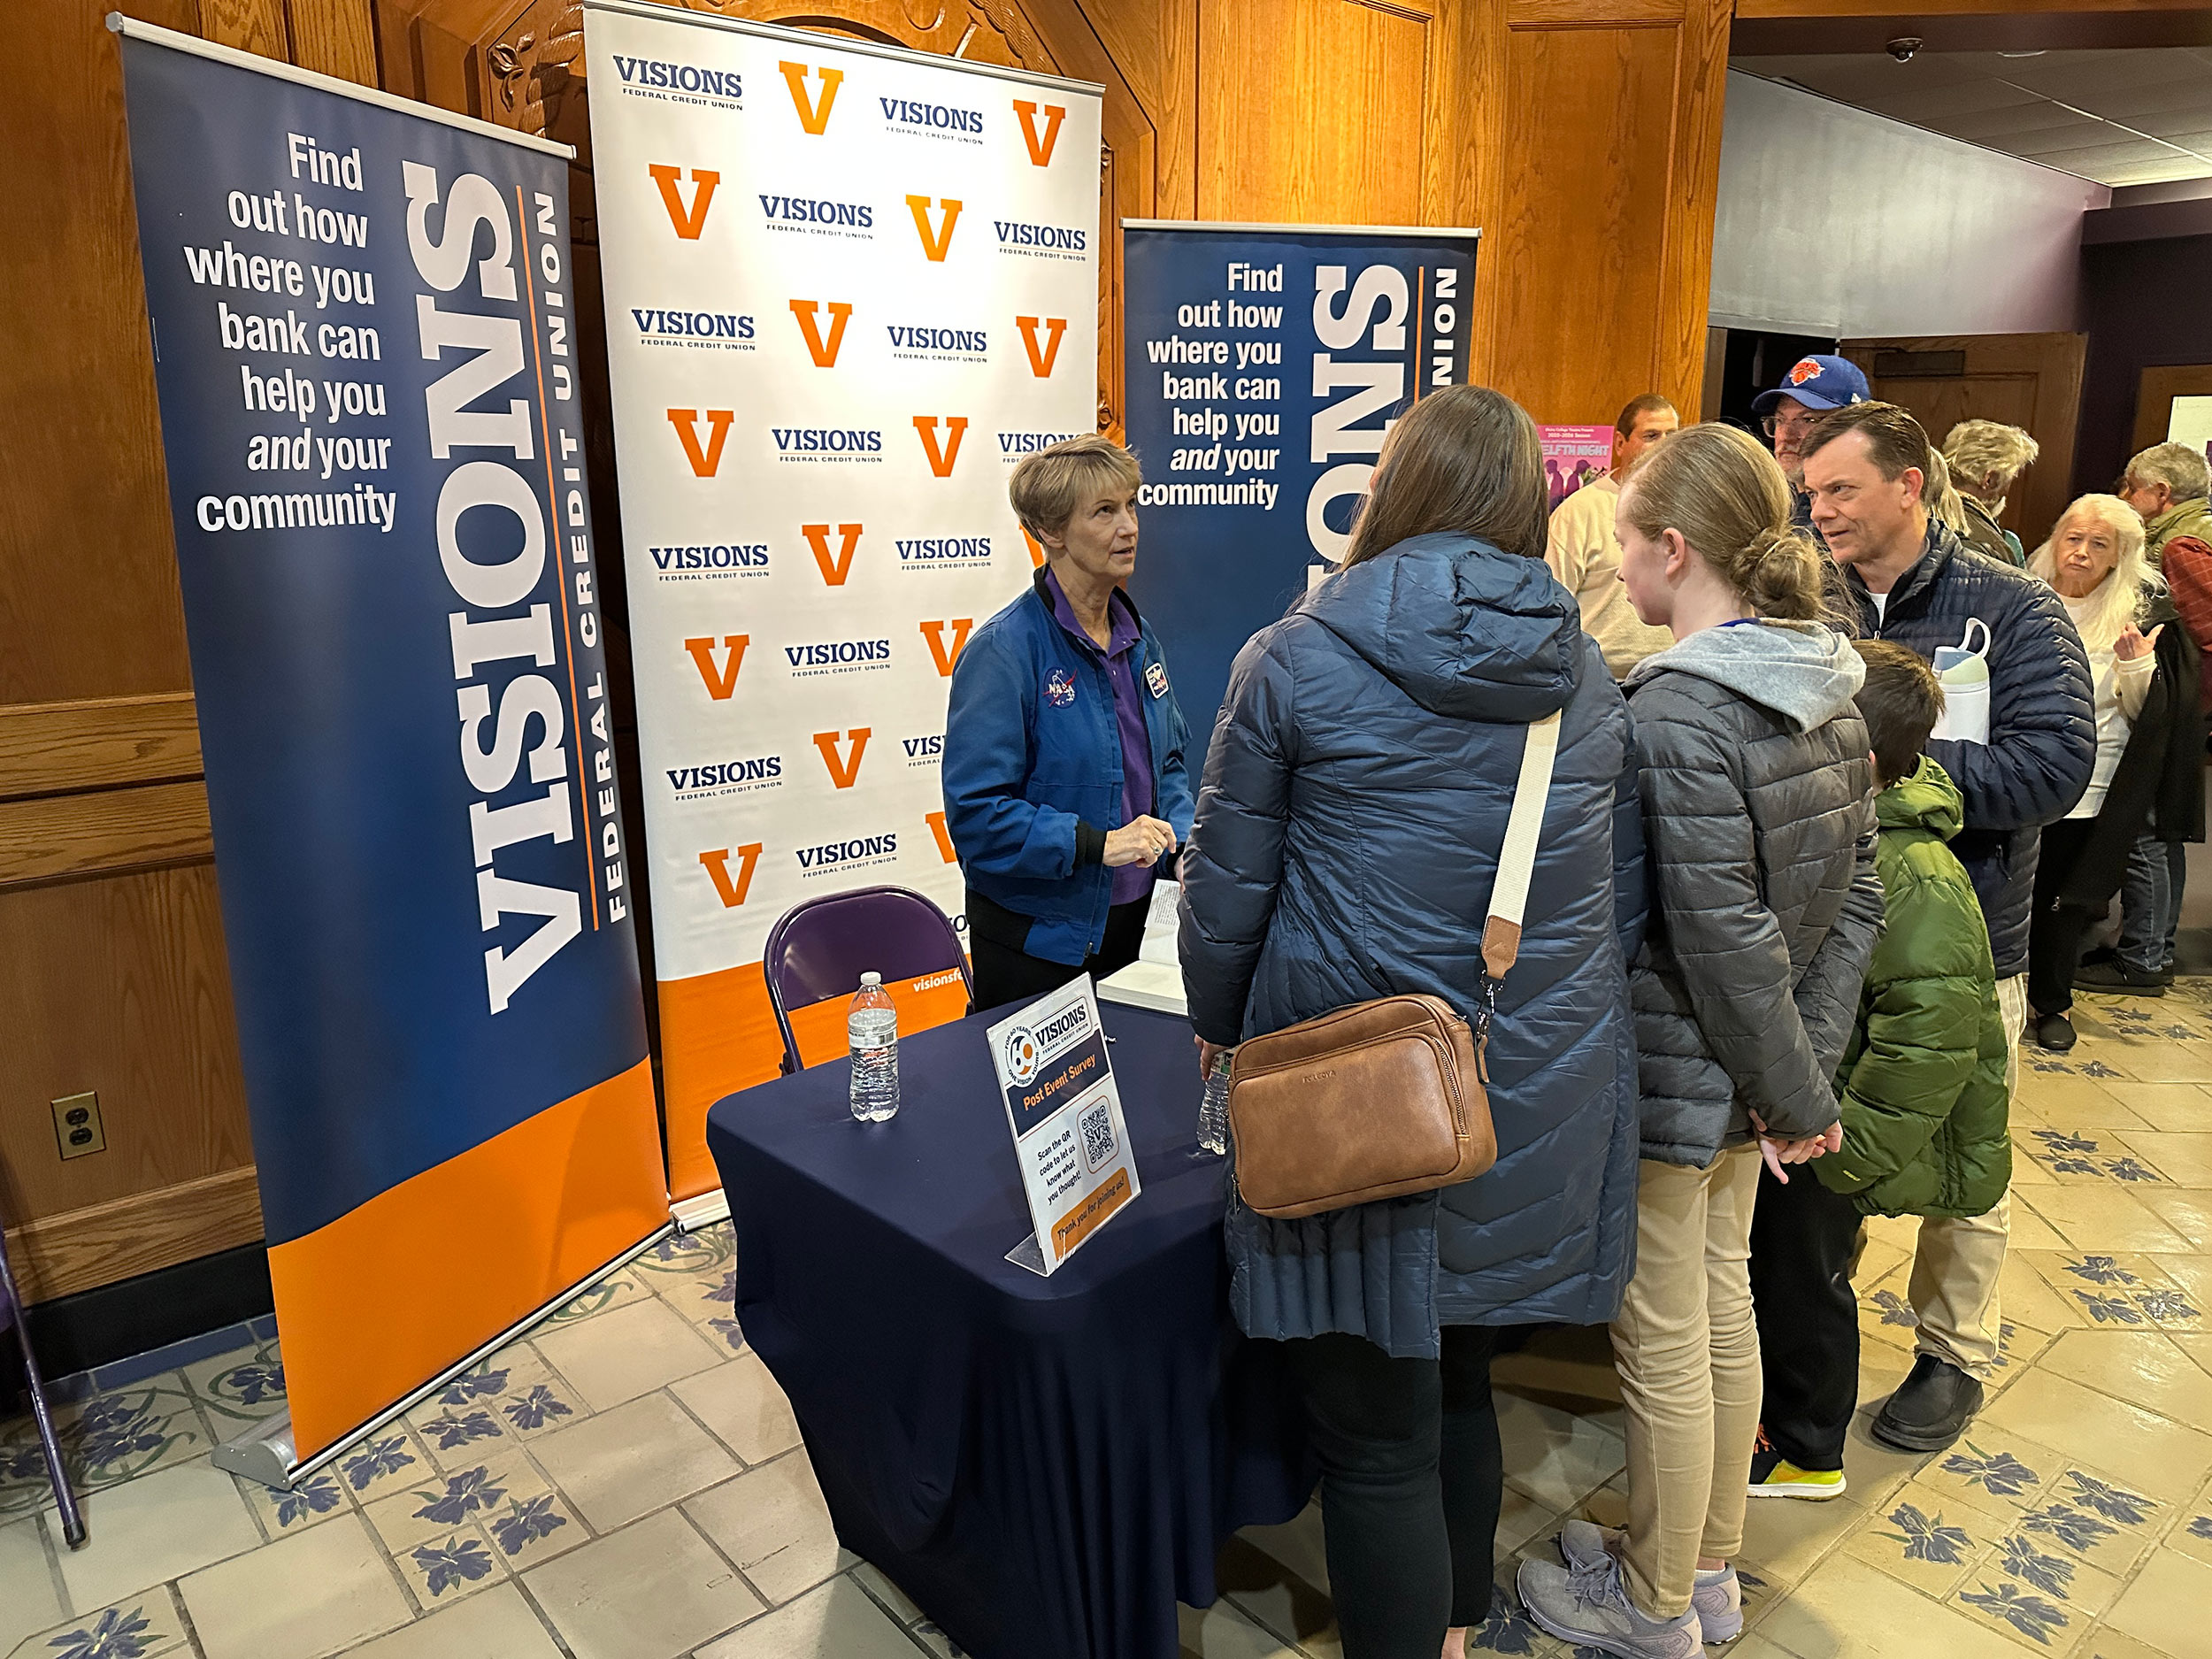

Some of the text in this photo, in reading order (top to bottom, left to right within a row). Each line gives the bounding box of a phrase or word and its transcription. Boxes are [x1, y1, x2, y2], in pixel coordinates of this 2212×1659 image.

[612, 55, 742, 98] VISIONS
[623, 88, 743, 111] FEDERAL CREDIT UNION
[779, 61, 843, 134] V
[879, 96, 983, 134] VISIONS
[1013, 99, 1065, 166] V
[288, 133, 363, 191] Find
[228, 190, 367, 248] out how
[649, 164, 719, 240] V
[758, 194, 872, 228] VISIONS
[766, 224, 806, 234] FEDERAL
[906, 195, 962, 262] V
[994, 221, 1086, 251] VISIONS
[999, 248, 1032, 257] FEDERAL
[184, 241, 374, 309] where you
[1227, 264, 1283, 292] Find
[219, 303, 380, 360] bank can
[631, 309, 755, 339] VISIONS
[1178, 300, 1283, 328] out how
[1432, 268, 1457, 389] NION
[789, 300, 852, 367] V
[887, 326, 987, 352] VISIONS
[1017, 316, 1066, 378] V
[1147, 335, 1281, 370] where you
[242, 365, 386, 423] help you
[1164, 372, 1280, 400] bank can
[772, 428, 882, 452] VISIONS
[1173, 408, 1280, 441] help you
[248, 427, 391, 479] and your
[667, 409, 733, 477] V
[913, 417, 968, 477] V
[997, 433, 1081, 453] VISIO
[1170, 443, 1279, 476] and your
[197, 484, 396, 532] community
[1137, 479, 1279, 510] community
[534, 192, 626, 924] FEDERAL CREDIT UNION
[649, 544, 769, 570] VISIONS
[803, 524, 863, 586] V
[895, 537, 991, 560] VISIONS
[403, 160, 581, 1015] VISIONS
[784, 640, 890, 666] VISIONS
[920, 618, 972, 676] V
[685, 634, 749, 700] V
[792, 669, 829, 678] FEDERAL
[1048, 683, 1075, 694] NASA
[813, 728, 871, 788] V
[902, 733, 944, 757] VIS
[665, 756, 781, 790] VISIONS
[908, 758, 941, 768] FEDERAL
[675, 780, 782, 802] FEDERAL CREDIT UNION
[795, 833, 897, 868] VISIONS
[803, 856, 897, 879] FEDERAL CREDIT UNION
[700, 843, 762, 908] V
[1035, 1004, 1087, 1047] VISIONS
[1042, 1023, 1088, 1055] FEDERAL CREDIT UNION
[1023, 1054, 1096, 1111] Post Event Survey
[1037, 1130, 1071, 1161] Scan the QR
[1039, 1162, 1054, 1176] code
[1054, 1156, 1061, 1165] to
[1068, 1143, 1076, 1155] us
[1046, 1159, 1076, 1187] know what
[1048, 1170, 1082, 1206] you thought!
[1056, 1218, 1077, 1240] Thank
[1076, 1210, 1087, 1226] you
[1087, 1202, 1097, 1215] for
[1096, 1187, 1116, 1210] joining
